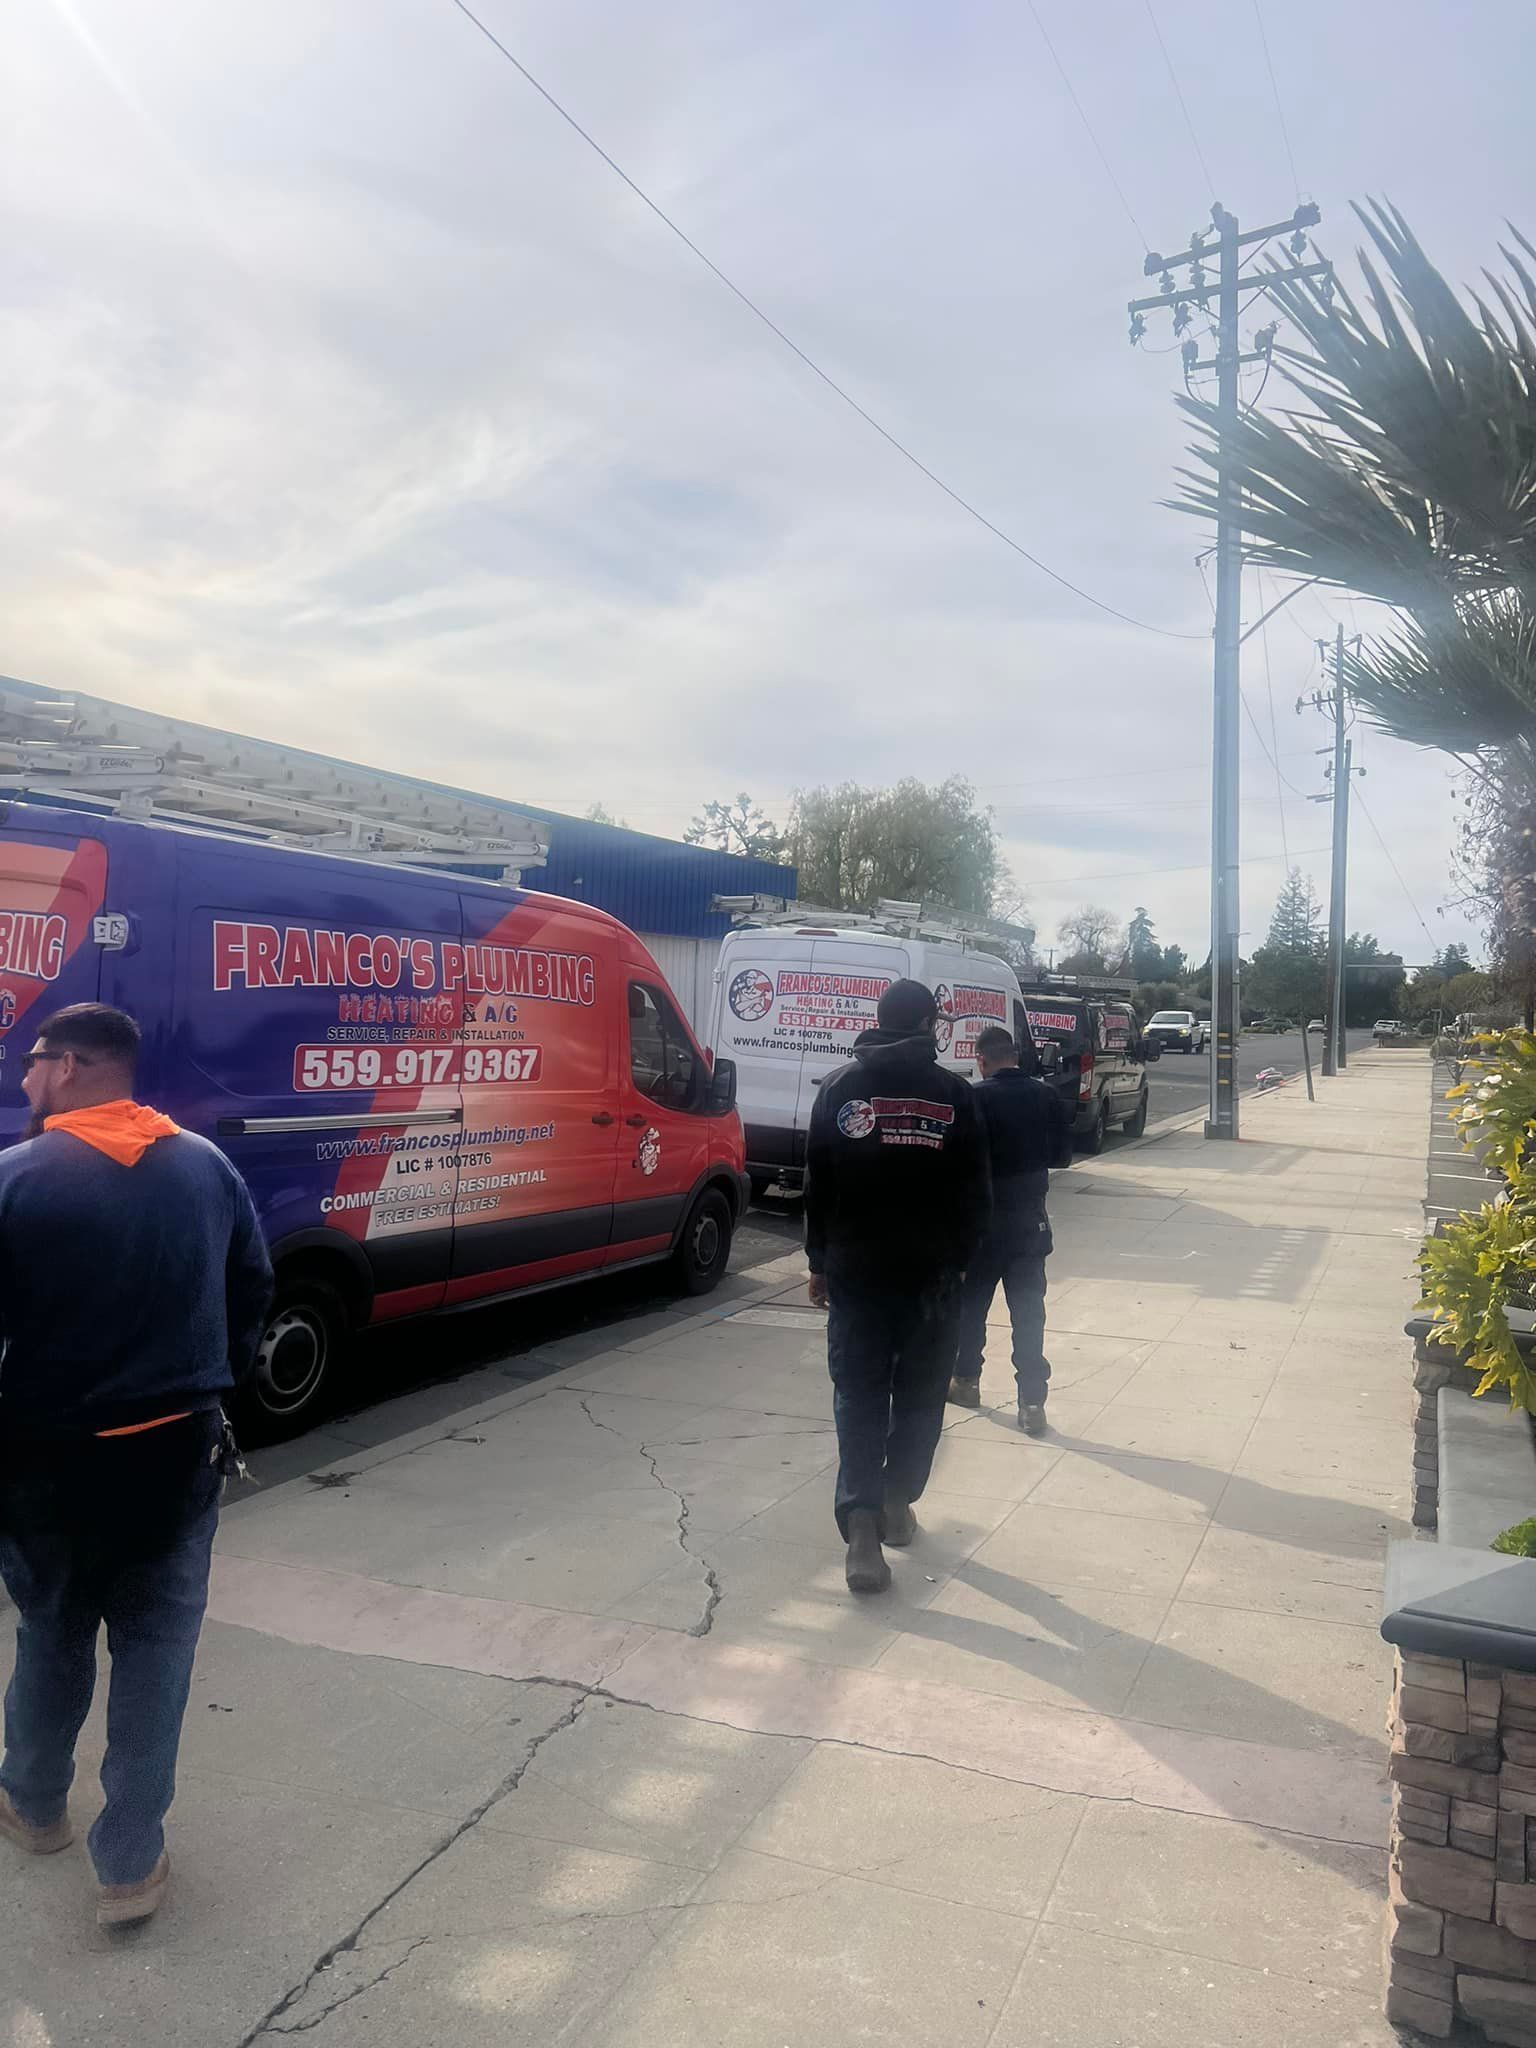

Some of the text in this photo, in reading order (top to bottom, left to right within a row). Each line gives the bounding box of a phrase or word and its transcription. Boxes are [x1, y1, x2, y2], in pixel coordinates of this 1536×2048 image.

[0, 912, 66, 981] BING
[213, 919, 595, 1006] FRANCO'S PLUMBING
[779, 973, 831, 994] FRANCO'S
[338, 992, 518, 1025] HEATING & A/C
[796, 995, 833, 1009] HEATING
[836, 999, 842, 1008] &
[327, 1026, 525, 1042] SERVICE, REPAIR & INSTALLATION
[773, 1027, 833, 1040] LIC # 1007876
[1034, 1012, 1077, 1032] PLUMBING
[732, 1037, 854, 1058] www.francosplumbing
[302, 1049, 538, 1088] 559.917.9367
[316, 1121, 556, 1160] www.francosplumbing.net
[396, 1152, 492, 1174] LIC # 1007876
[320, 1169, 547, 1213] COMMERCIAL & RESIDENTIAL
[375, 1196, 501, 1227] FREE ESTIMATES!
